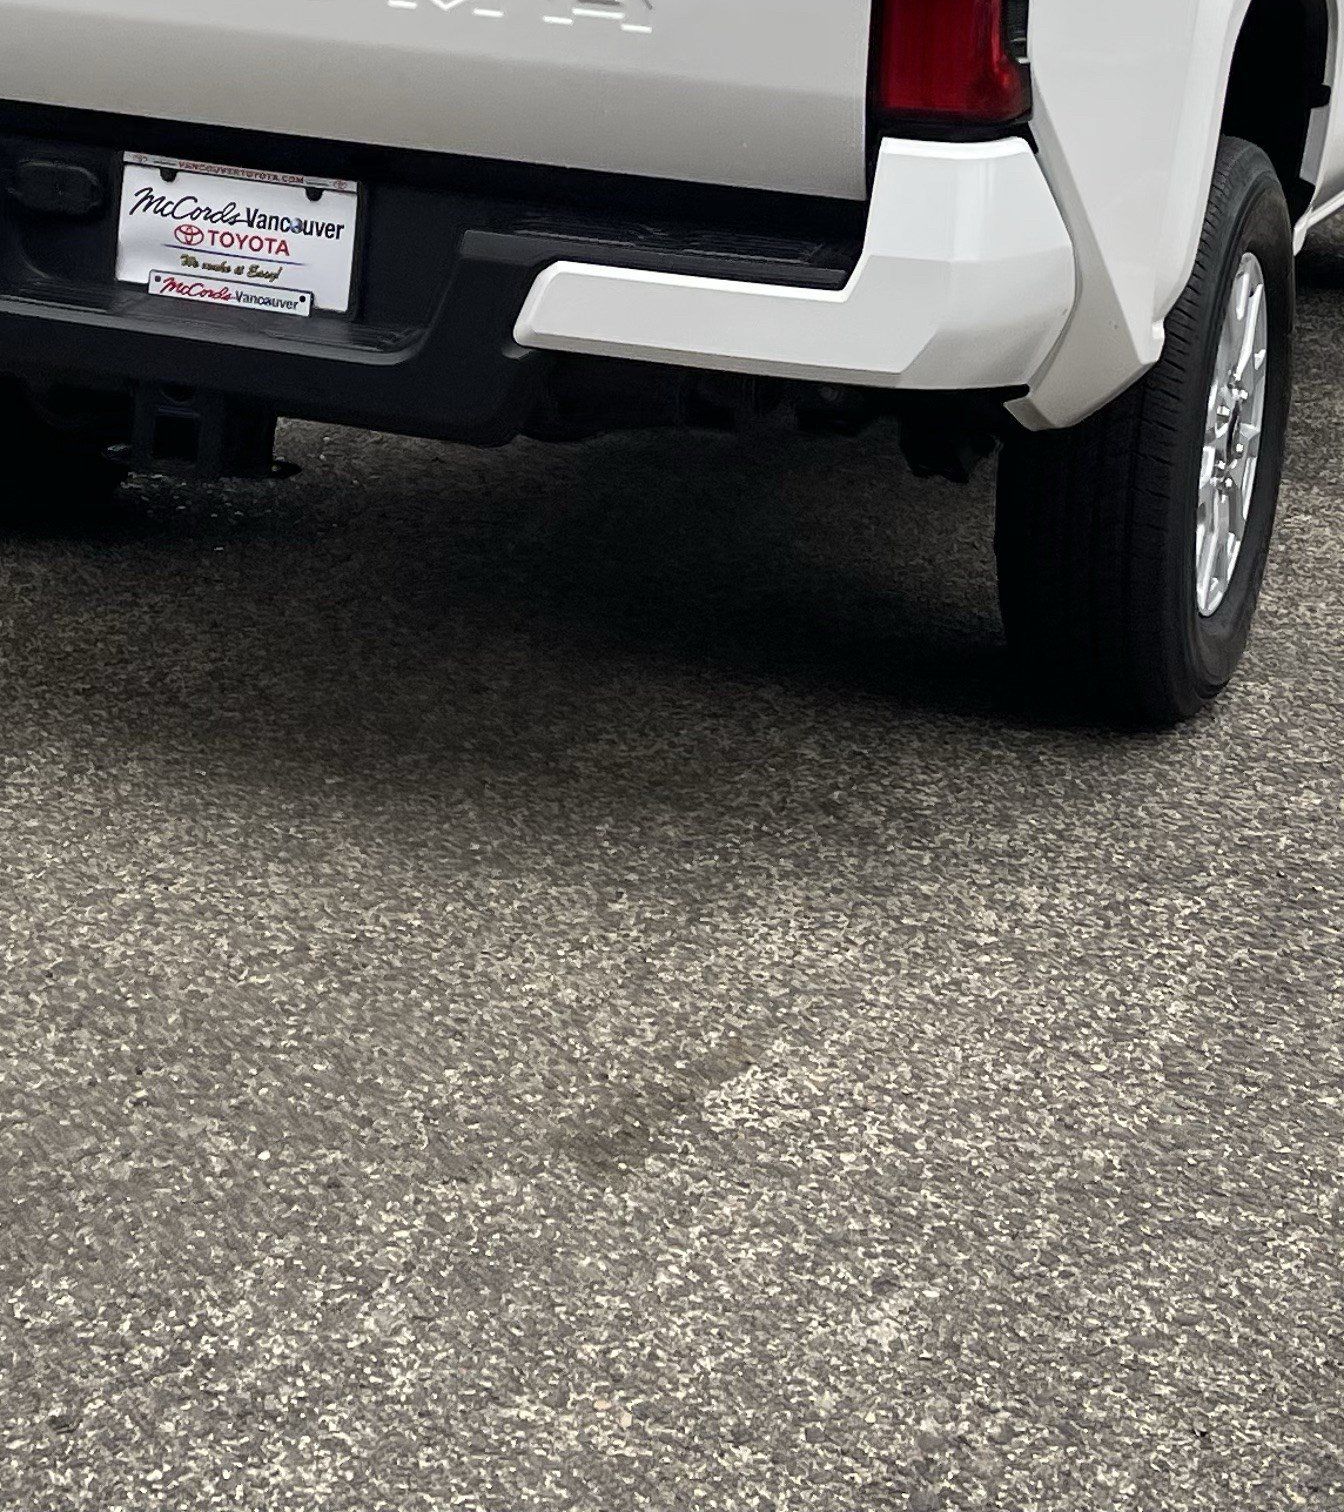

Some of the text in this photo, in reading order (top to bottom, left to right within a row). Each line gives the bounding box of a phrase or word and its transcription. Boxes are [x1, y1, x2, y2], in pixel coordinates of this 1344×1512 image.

[128, 186, 345, 240] McCords Vancouver
[207, 229, 291, 257] TOYOTA
[159, 276, 299, 310] McCords Vancouver
